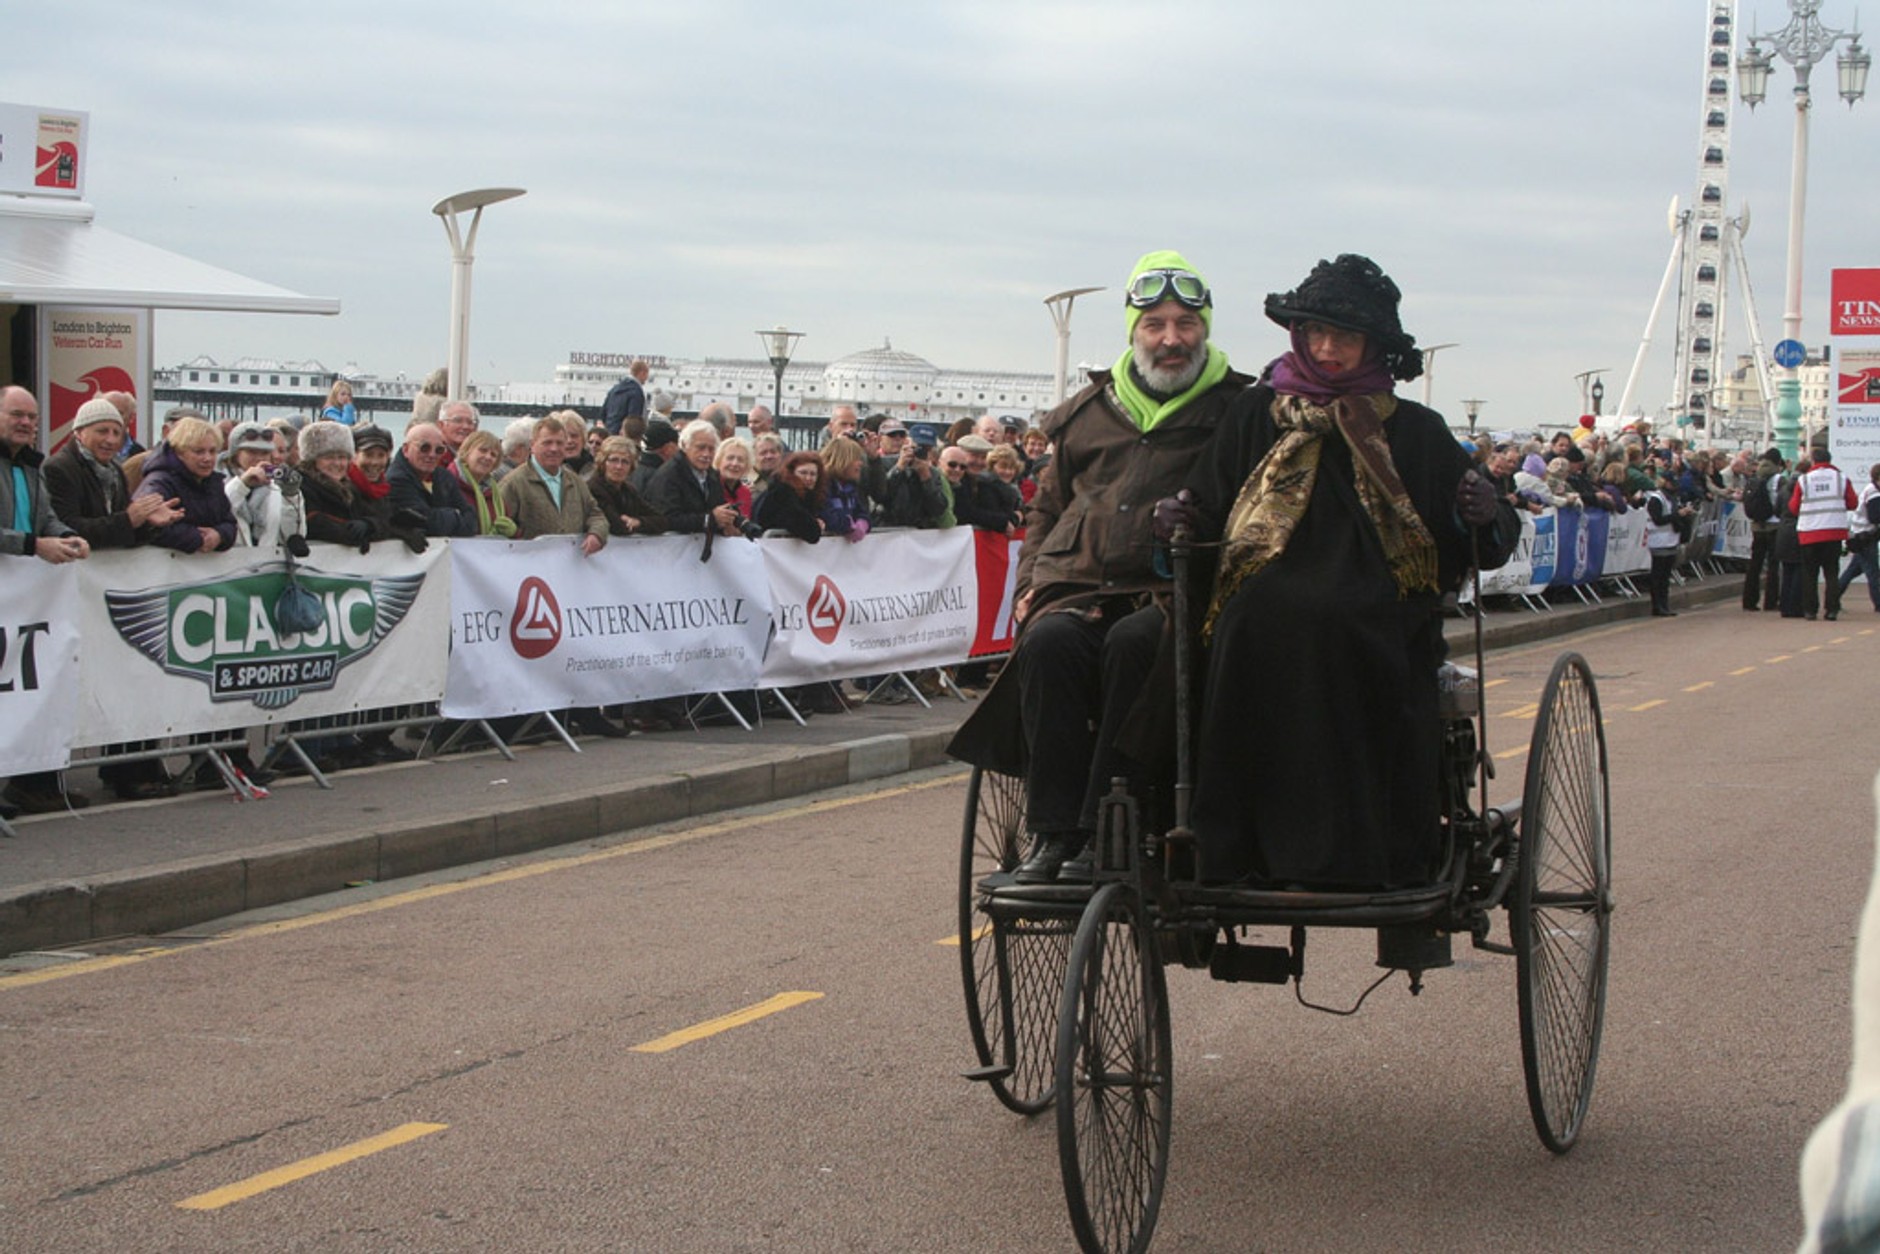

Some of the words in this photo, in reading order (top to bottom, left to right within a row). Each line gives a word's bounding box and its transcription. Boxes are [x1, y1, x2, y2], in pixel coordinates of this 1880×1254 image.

[53, 321, 86, 333] London
[86, 322, 95, 333] to
[96, 321, 132, 336] Brighton
[53, 336, 88, 348] Veteran
[88, 336, 104, 348] Car
[105, 337, 123, 348] Run
[570, 352, 635, 367] BRIGHTON
[849, 585, 968, 625] INTERNATIONAL
[171, 587, 373, 664] CLASIC
[462, 609, 503, 644] EFG
[565, 597, 749, 638] INTERNATIONAL
[565, 656, 624, 672] Practitioners
[626, 653, 635, 667] of
[637, 651, 651, 666] the
[653, 650, 672, 665] craft
[674, 650, 684, 663] of
[684, 648, 713, 663] private
[220, 668, 233, 688] &
[236, 664, 299, 687] SPORTS
[301, 659, 333, 680] CAR
